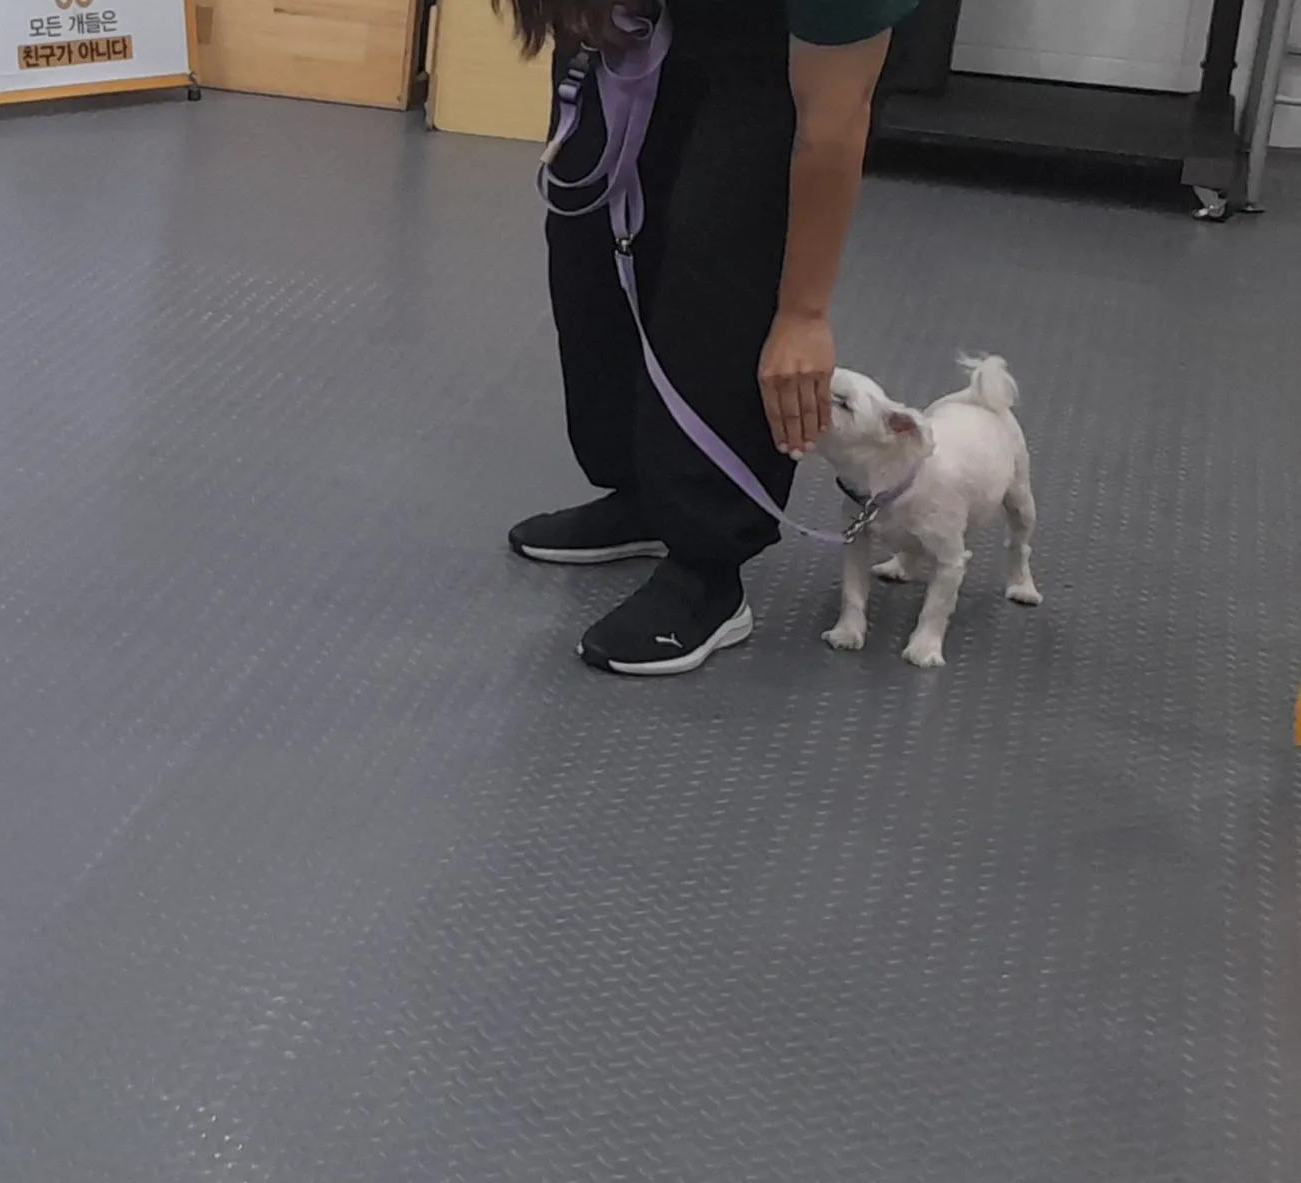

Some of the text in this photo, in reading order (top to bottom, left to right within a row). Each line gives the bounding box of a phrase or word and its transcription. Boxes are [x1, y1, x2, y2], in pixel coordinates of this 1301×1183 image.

[29, 10, 118, 37] 모든 개들은
[23, 38, 128, 67] 친구가 아니다
